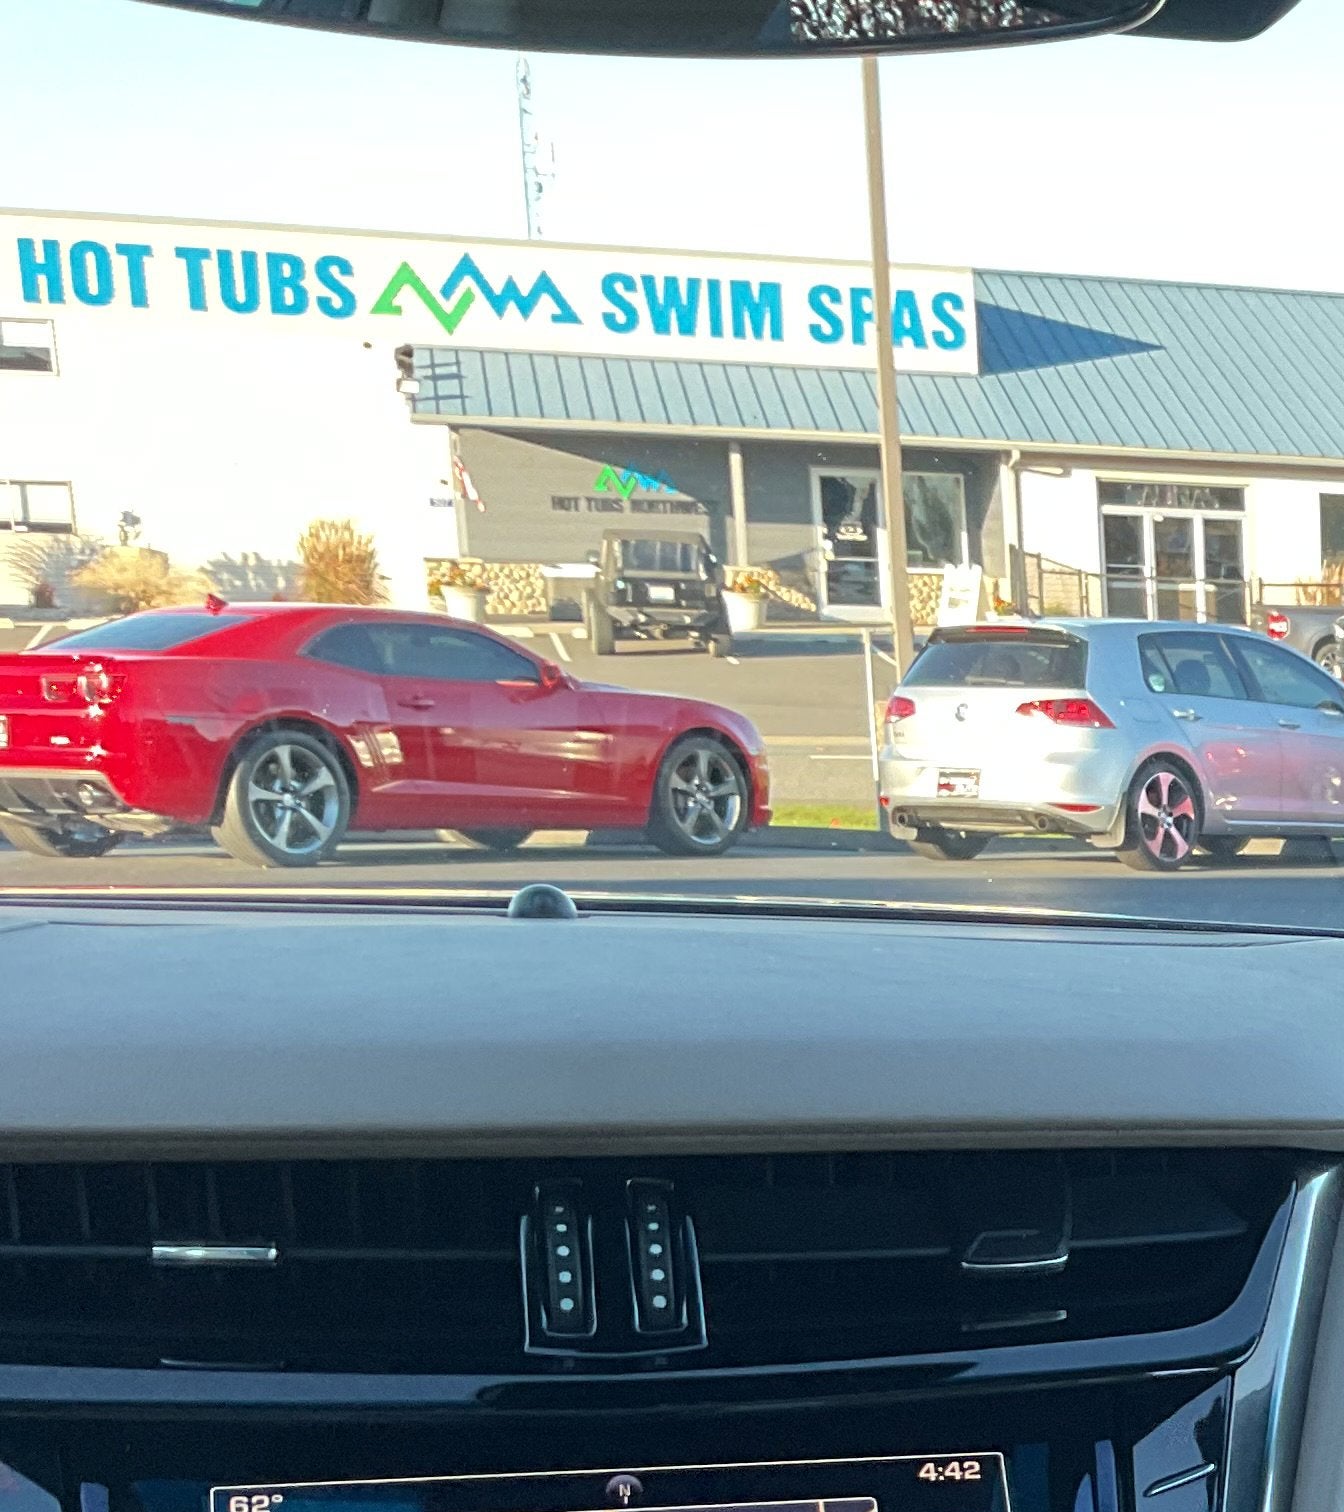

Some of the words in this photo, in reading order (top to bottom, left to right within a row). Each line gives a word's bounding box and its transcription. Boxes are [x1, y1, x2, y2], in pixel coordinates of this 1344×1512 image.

[17, 238, 154, 308] HOT
[175, 246, 358, 320] TUBS
[601, 271, 784, 343] SWIM
[808, 284, 967, 351] SPAS
[630, 499, 717, 516] NORTHWES
[917, 1460, 981, 1483] 4:42
